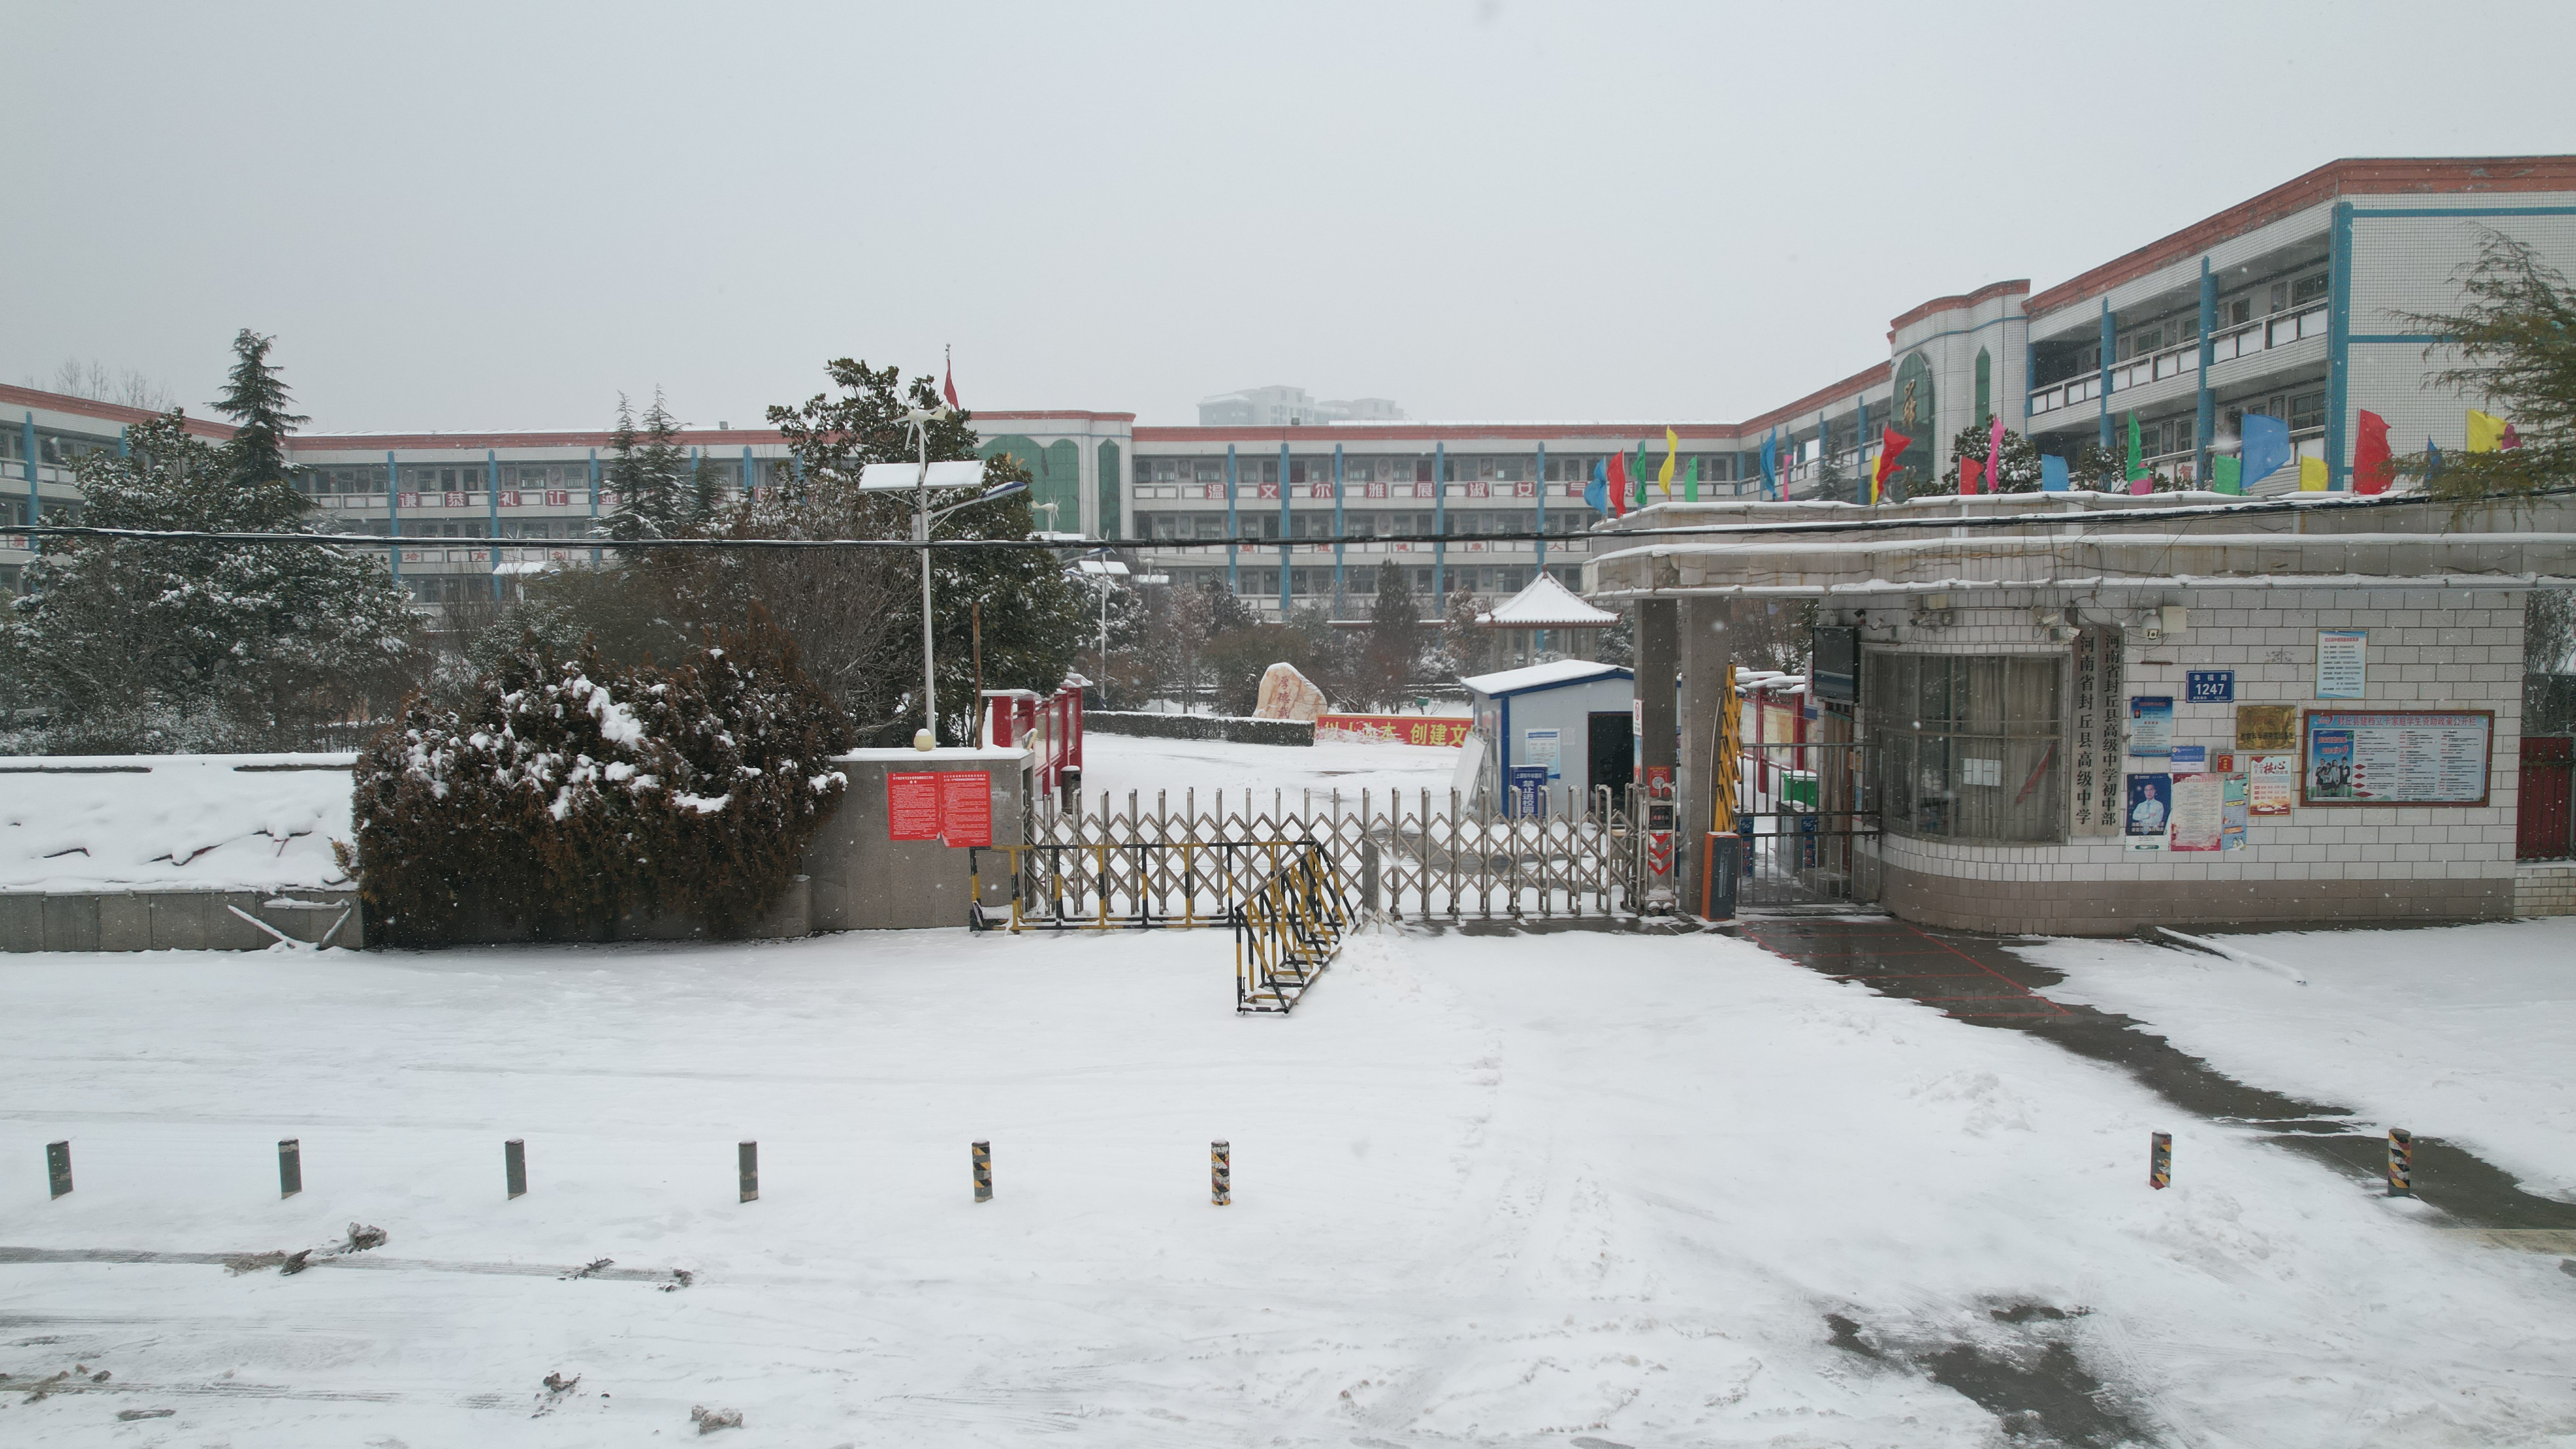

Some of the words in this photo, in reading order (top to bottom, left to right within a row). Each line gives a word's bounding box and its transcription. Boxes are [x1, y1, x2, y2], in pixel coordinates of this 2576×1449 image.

[2196, 684, 2224, 695] 1247
[1410, 723, 1474, 746] 创建文
[2076, 636, 2095, 824] 河南省封丘县高级中学
[2101, 635, 2120, 826] 河南省封丘县高级中学初中部
[2337, 716, 2476, 726] 封丘县建档立卡家庭学生资助政策公开栏
[1522, 780, 1535, 813] 禁止进校园
